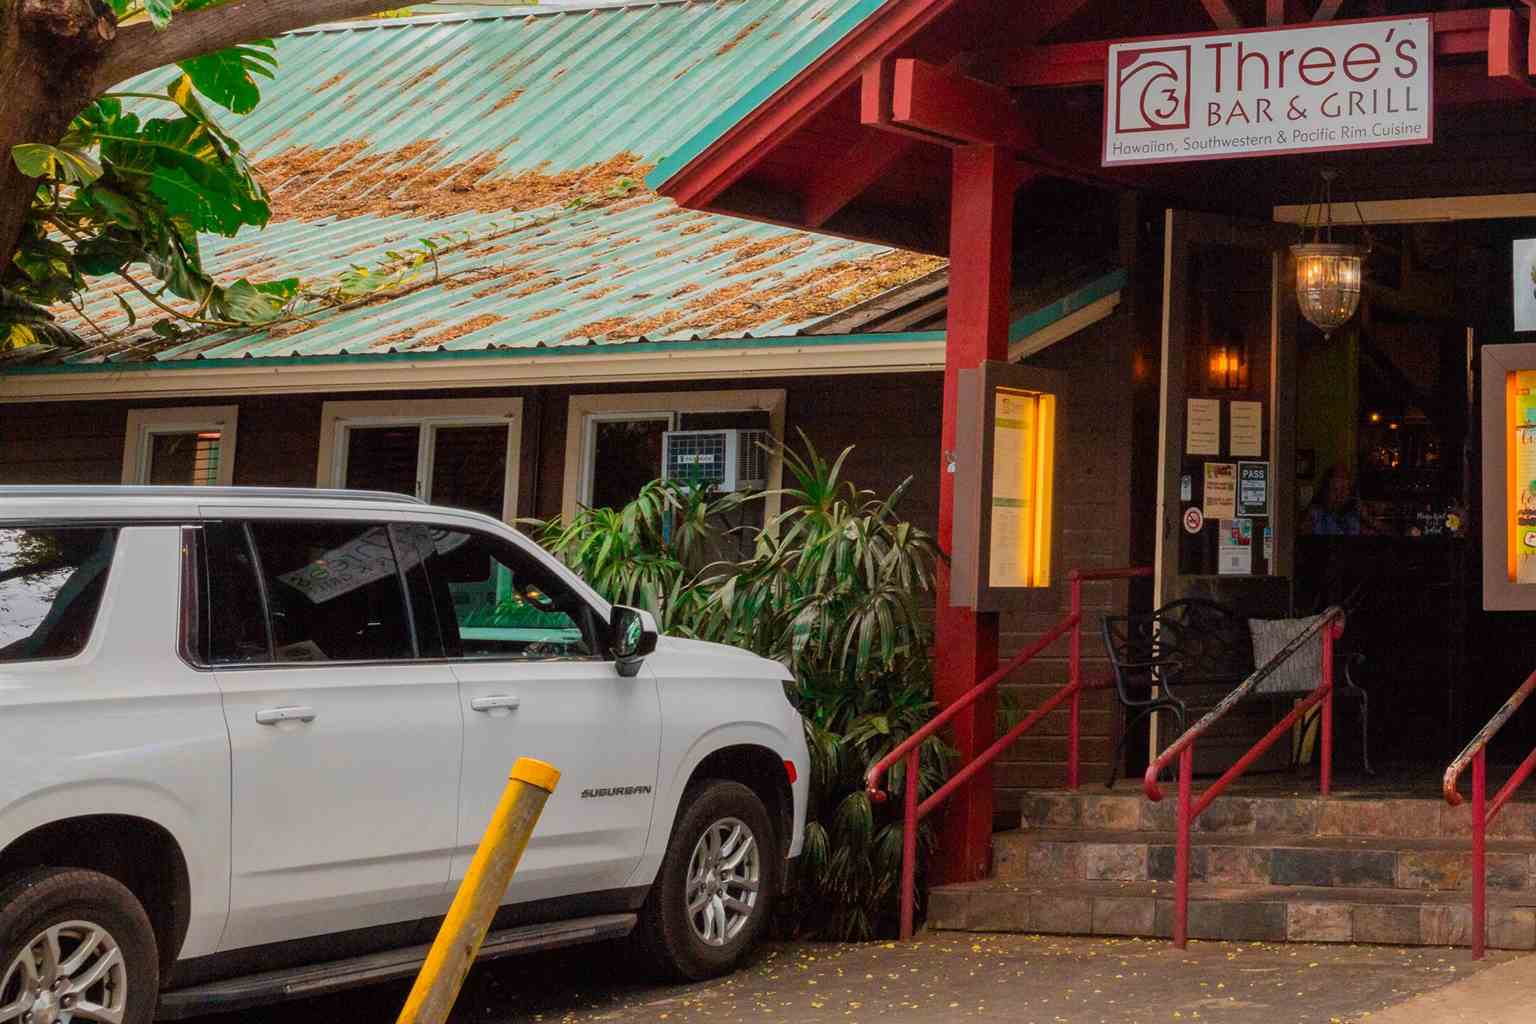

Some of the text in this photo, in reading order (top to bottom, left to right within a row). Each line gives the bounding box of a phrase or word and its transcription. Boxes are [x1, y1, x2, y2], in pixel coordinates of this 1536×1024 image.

[1205, 28, 1418, 93] Three's
[1154, 89, 1179, 118] 3
[1208, 86, 1419, 127] BAR & GRILL
[1112, 120, 1422, 156] Hawaiian, Southwestern & Pacific Rim Cuisine
[1242, 469, 1265, 479] PASS
[581, 785, 651, 798] SUBURBAN
